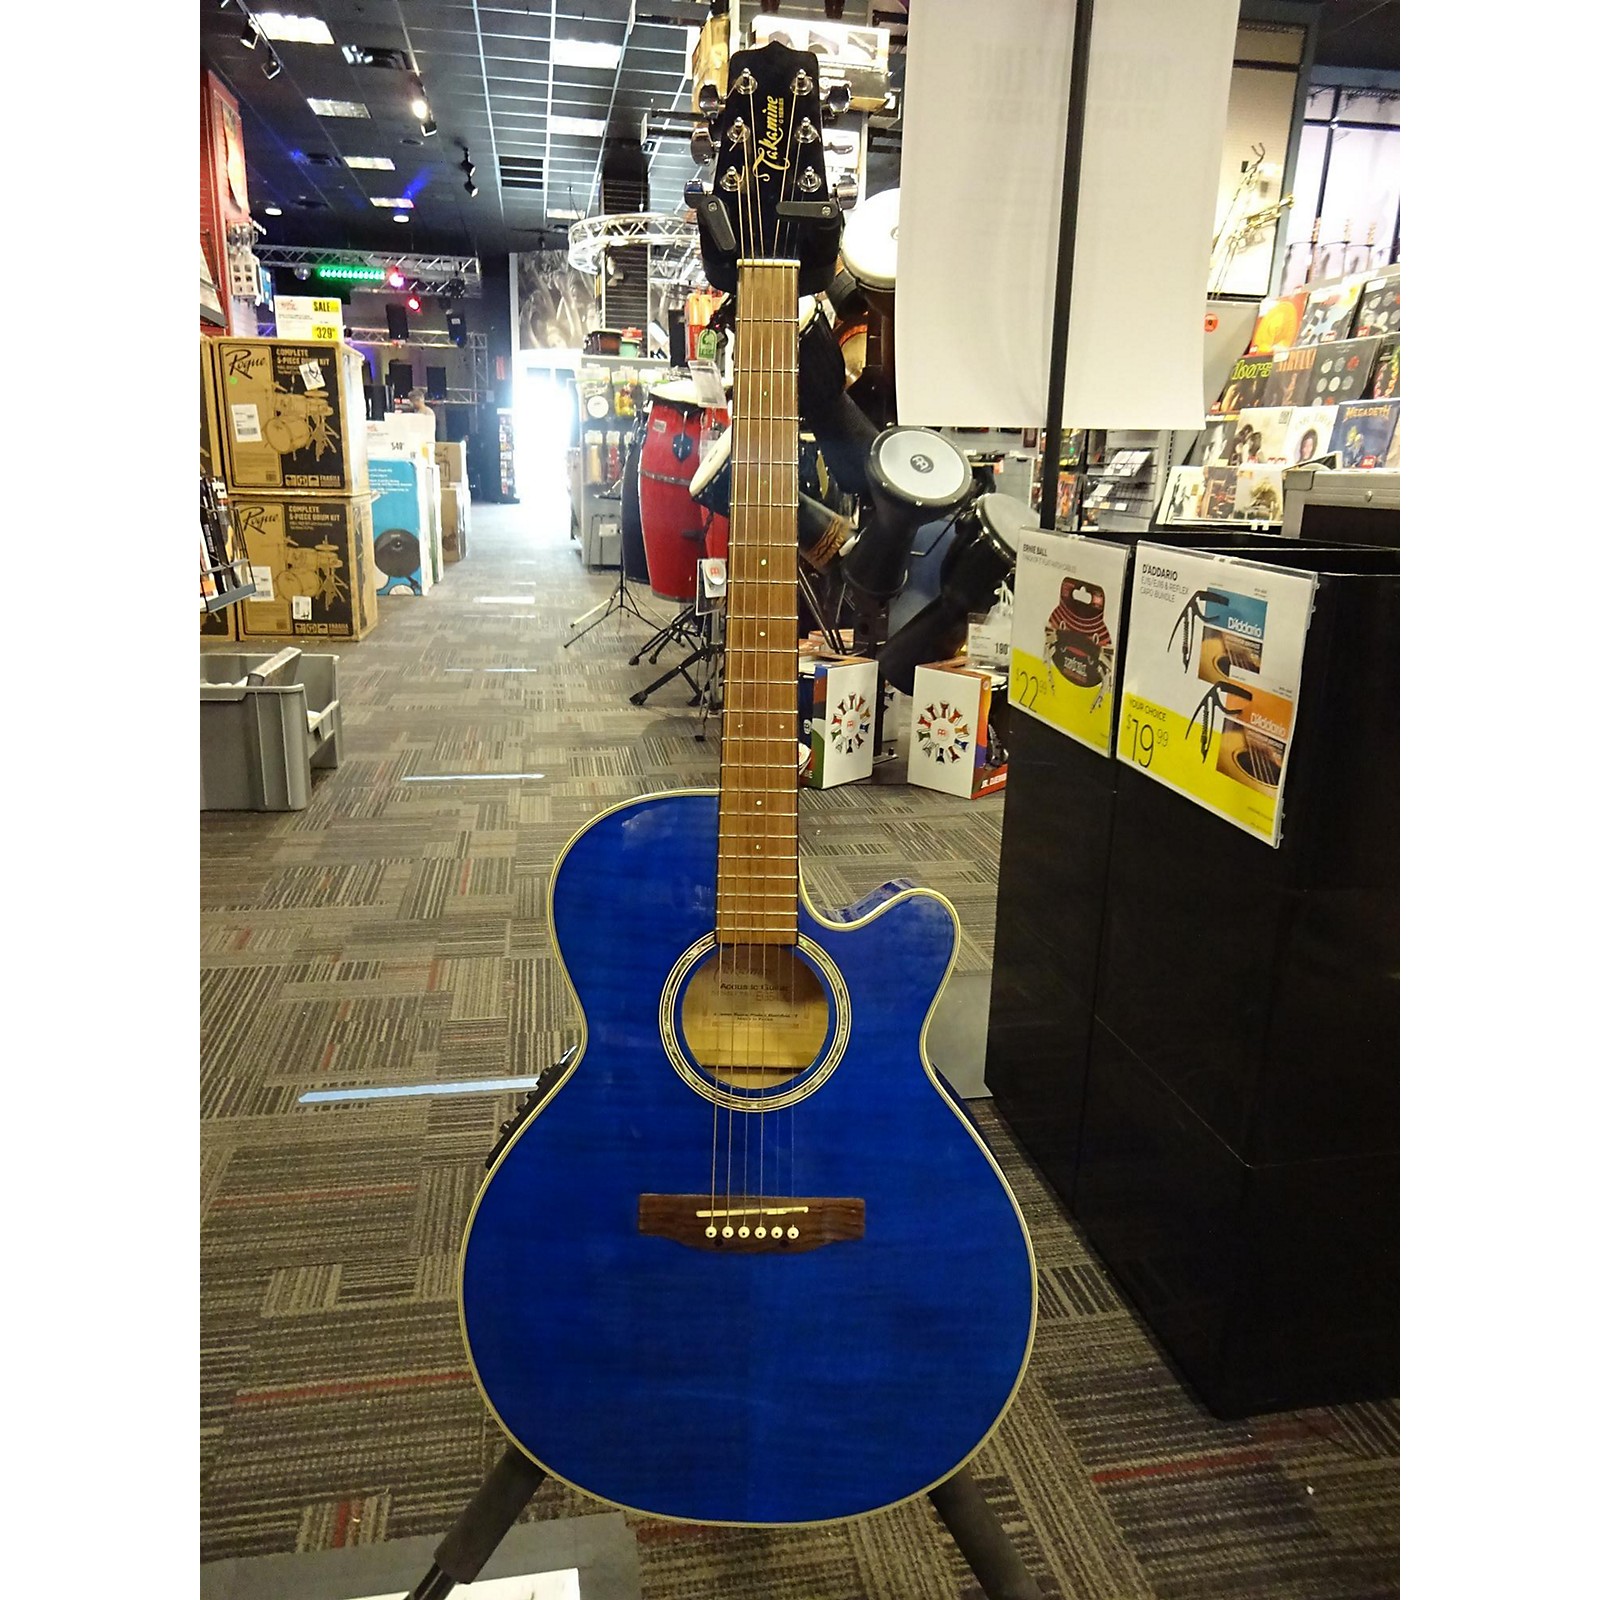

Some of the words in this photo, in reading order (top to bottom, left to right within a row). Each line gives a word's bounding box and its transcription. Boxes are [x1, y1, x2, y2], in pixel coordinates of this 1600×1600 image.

[752, 95, 791, 182] Takamine
[313, 301, 330, 312] SALE
[276, 348, 309, 357] COMPLETE
[225, 348, 266, 380] Rogue
[319, 358, 330, 366] KIT
[1342, 404, 1392, 422] MEGADETH
[288, 505, 320, 514] COMPLETE
[240, 506, 279, 535] Rogue
[329, 514, 341, 522] KIT
[1023, 543, 1036, 555] ERNIE
[1036, 546, 1048, 557] BALL
[1142, 563, 1179, 581] D'ADDARIO
[1169, 582, 1189, 596] REFLEX
[1154, 590, 1176, 603] BUNDLE
[1228, 616, 1262, 638] D'Addario
[1129, 699, 1145, 712] YOUR
[1144, 704, 1167, 722] CHOICE
[1250, 712, 1287, 738] D'Addario
[720, 982, 759, 991] Acousic
